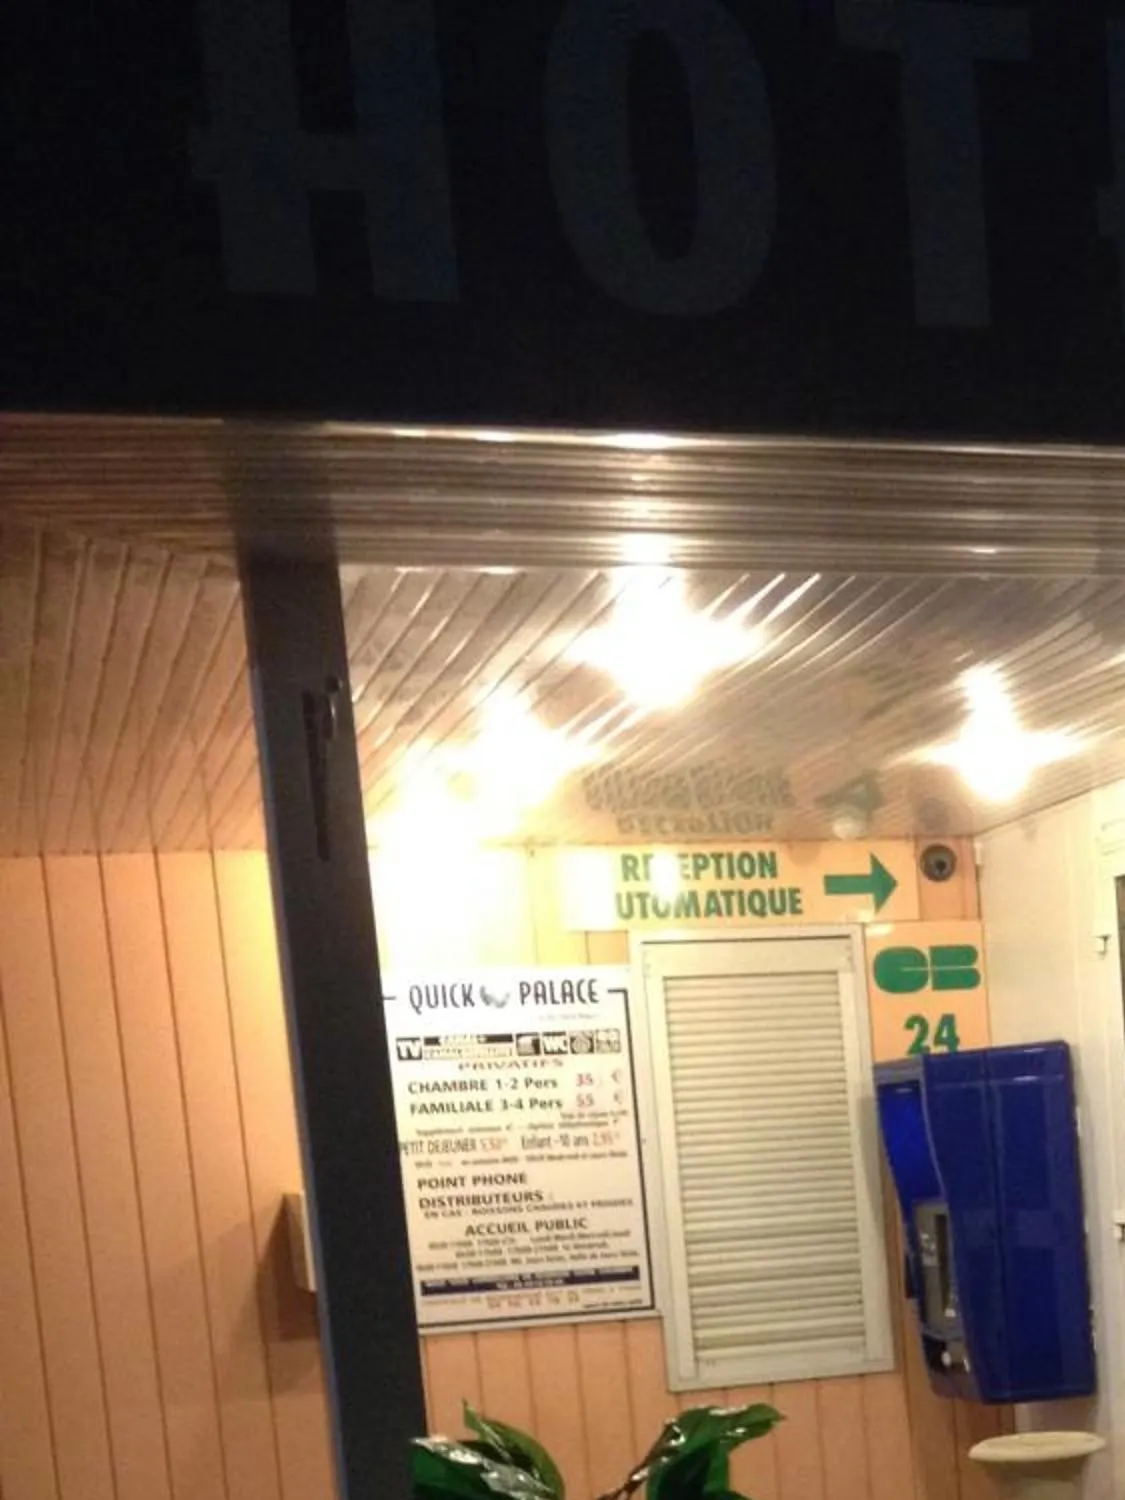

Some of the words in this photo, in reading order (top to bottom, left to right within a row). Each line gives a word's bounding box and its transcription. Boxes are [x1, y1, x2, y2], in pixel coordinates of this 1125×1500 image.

[615, 886, 804, 919] UTOMATIQUE
[874, 945, 980, 993] CB
[409, 983, 475, 1015] QUICK
[519, 978, 600, 1006] PALACE
[904, 1014, 960, 1057] 24
[408, 1079, 488, 1095] CHAMBRE
[496, 1077, 519, 1091] 1-2
[524, 1076, 558, 1090] Pers
[410, 1099, 493, 1115] FAMILIALE
[500, 1097, 523, 1111] 3-4
[529, 1096, 563, 1110] Pers
[417, 1176, 465, 1190] POINT
[472, 1171, 527, 1186] PHONE
[464, 1221, 528, 1237] ACCUEIL
[535, 1216, 588, 1232] PUBLIC
